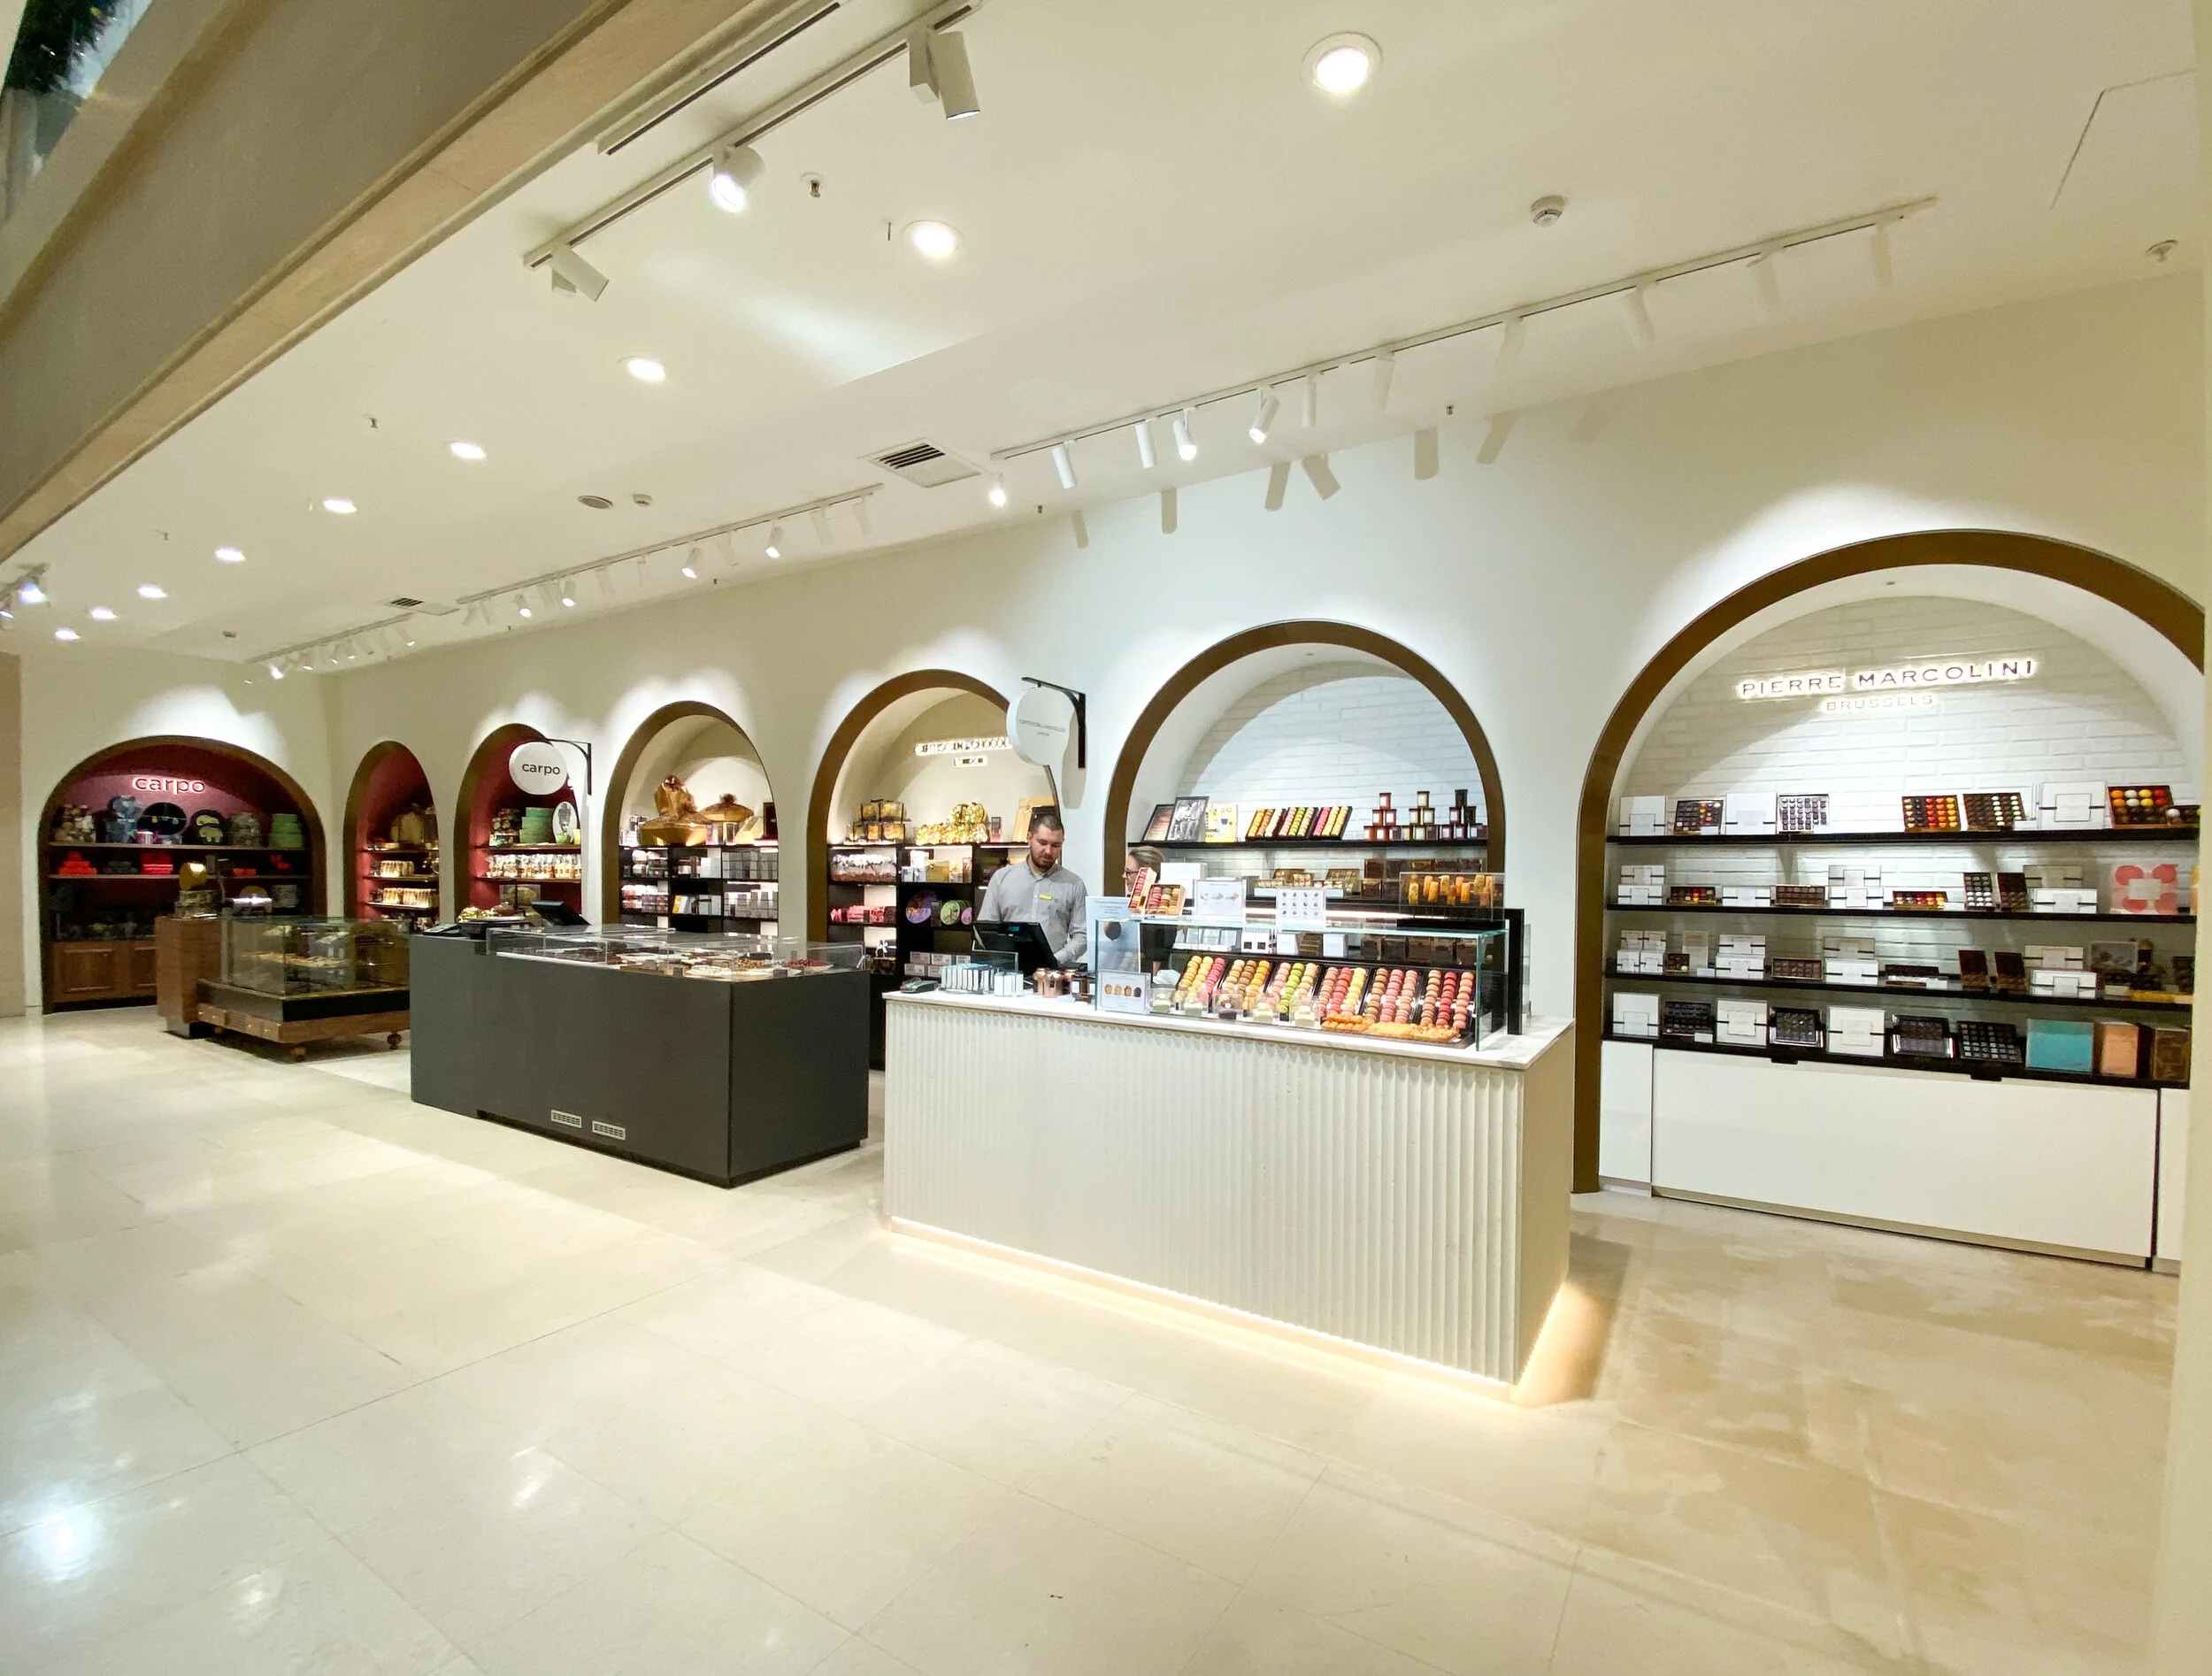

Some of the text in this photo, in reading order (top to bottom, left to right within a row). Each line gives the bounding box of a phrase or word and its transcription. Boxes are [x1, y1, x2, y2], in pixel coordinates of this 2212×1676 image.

[1743, 661, 2032, 695] PIERRE MARCOLINI
[1827, 696, 1933, 711] BRUSSELS
[522, 763, 560, 775] carpo
[134, 778, 205, 795] carpo
